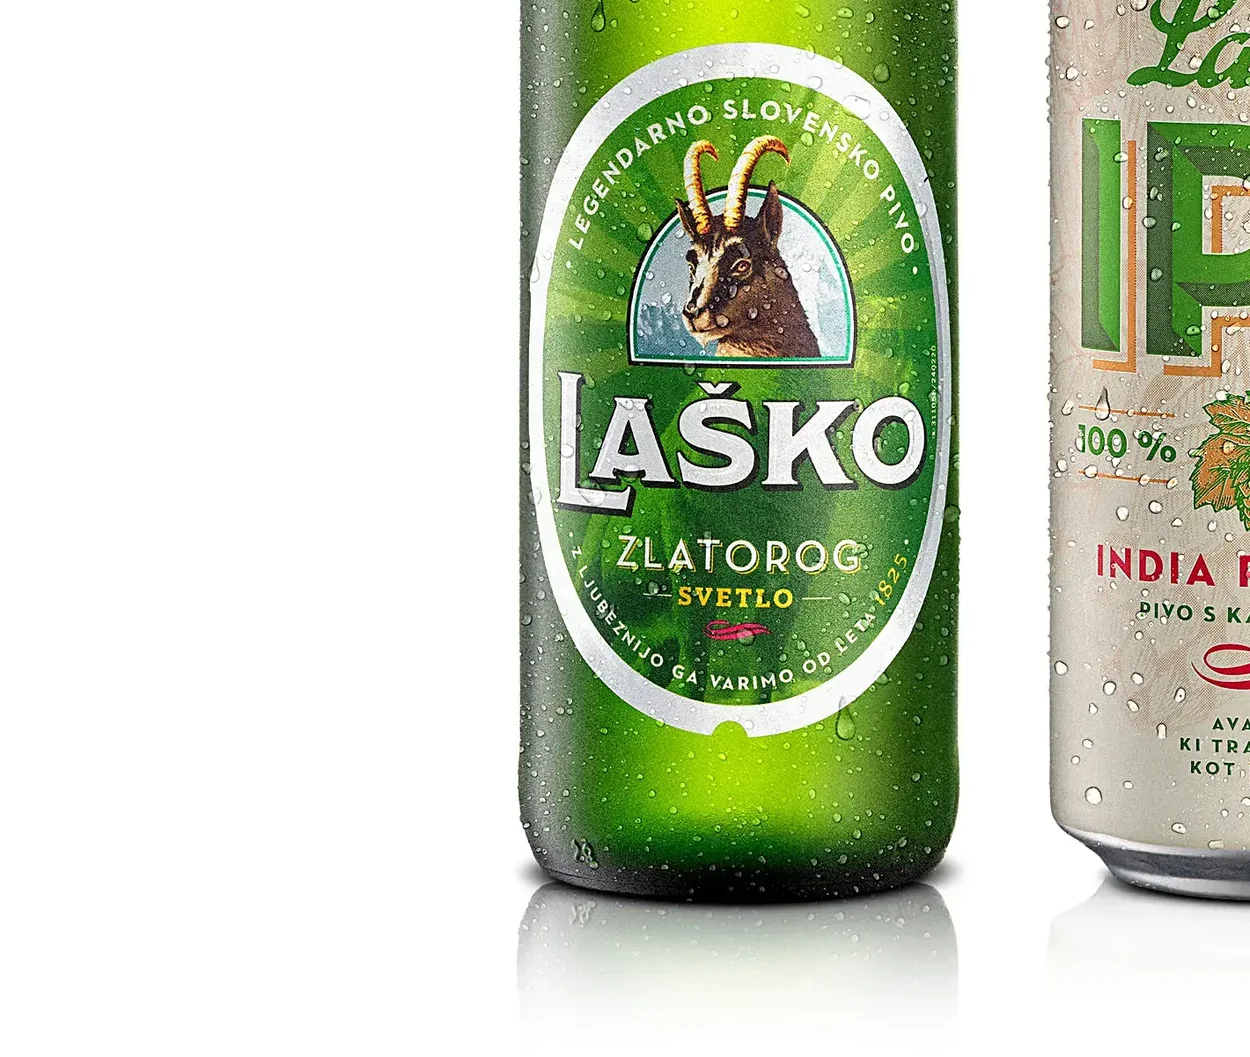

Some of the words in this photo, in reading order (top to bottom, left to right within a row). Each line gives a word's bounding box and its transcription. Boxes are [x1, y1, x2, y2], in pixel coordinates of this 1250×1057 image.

[569, 104, 710, 252] LEGENDARNO
[723, 99, 880, 181] SLOVENSKO
[880, 188, 915, 254] PIVO
[556, 371, 927, 517] LAŠKO
[1077, 422, 1128, 459] 100
[1137, 430, 1177, 463] %
[617, 534, 863, 574] ZLATOROG
[1097, 544, 1215, 588] INDIA
[678, 586, 794, 609] SVETLO
[1139, 601, 1193, 622] PIVO
[1204, 606, 1215, 622] S
[578, 565, 664, 669] LJUBEZNIJO
[672, 665, 699, 686] GA
[711, 669, 794, 691] VARIMO
[803, 651, 831, 675] OD
[836, 613, 876, 654] LETA
[875, 553, 908, 607] 1825
[1180, 737, 1201, 752] KI
[1191, 759, 1235, 775] KOT
